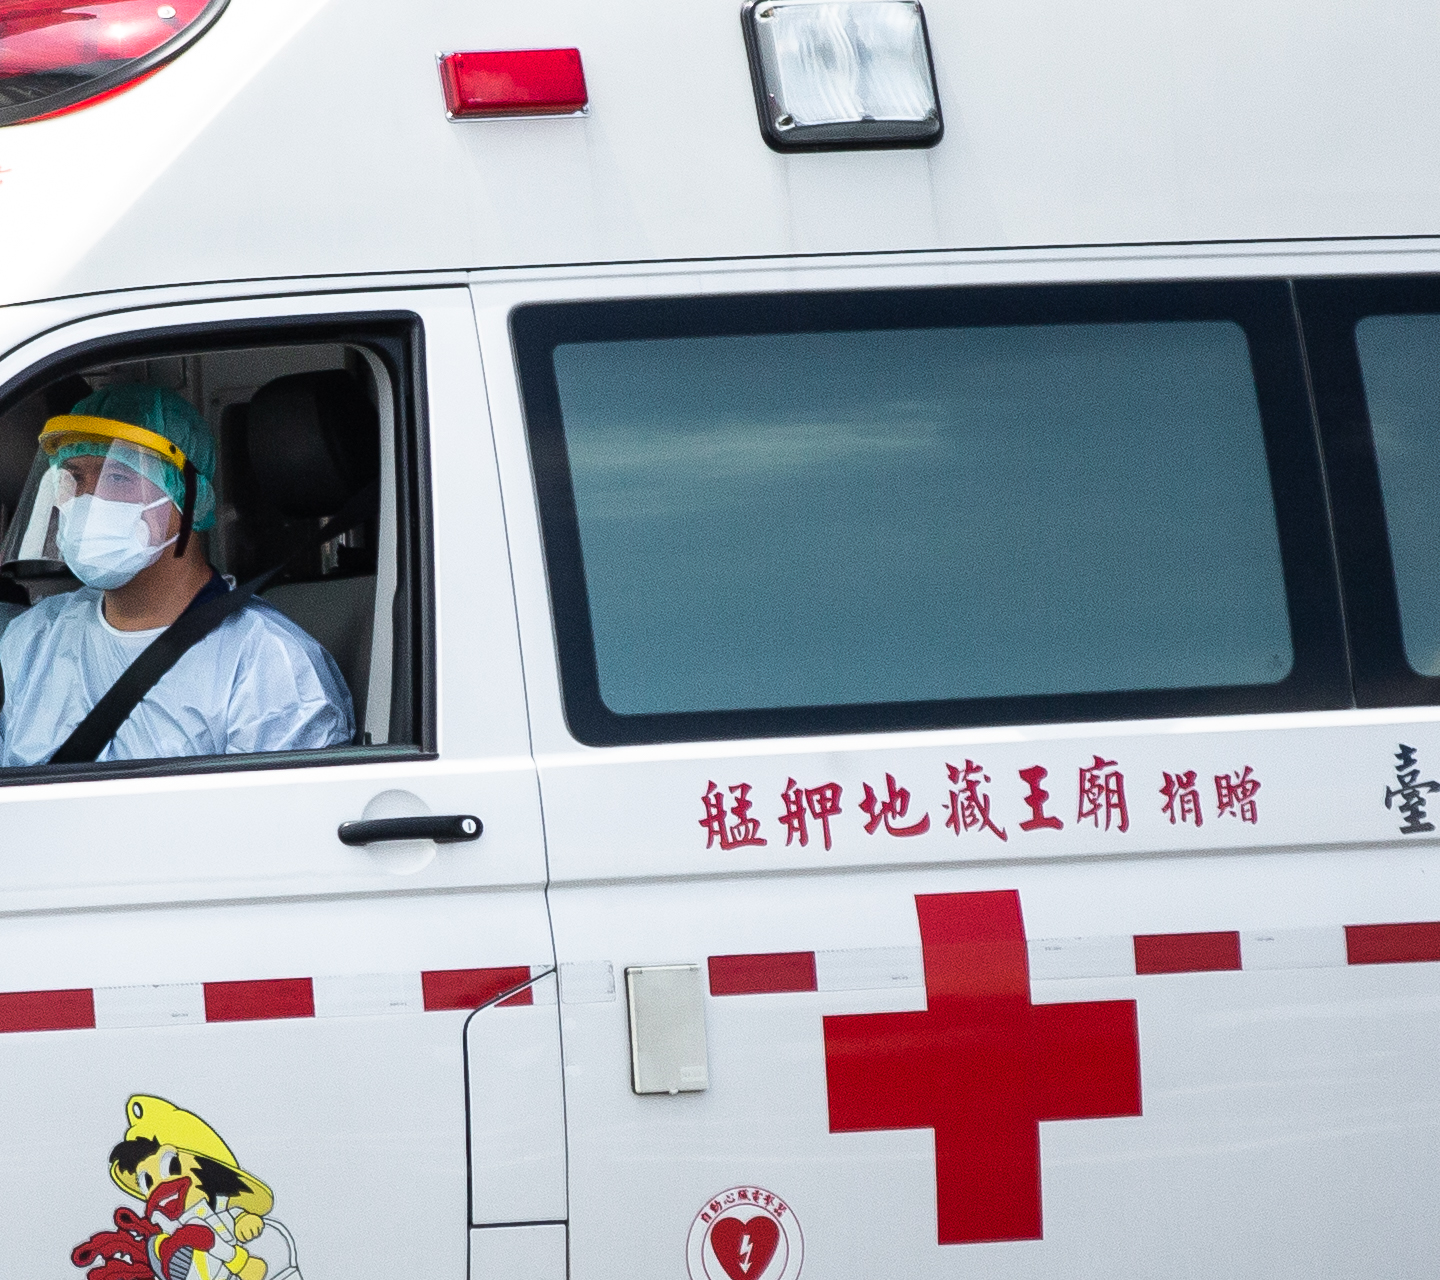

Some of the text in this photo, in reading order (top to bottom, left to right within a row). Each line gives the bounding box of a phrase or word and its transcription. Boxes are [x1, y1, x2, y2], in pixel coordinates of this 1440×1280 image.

[698, 754, 1262, 852] 艋舺地藏王廟 捐贈
